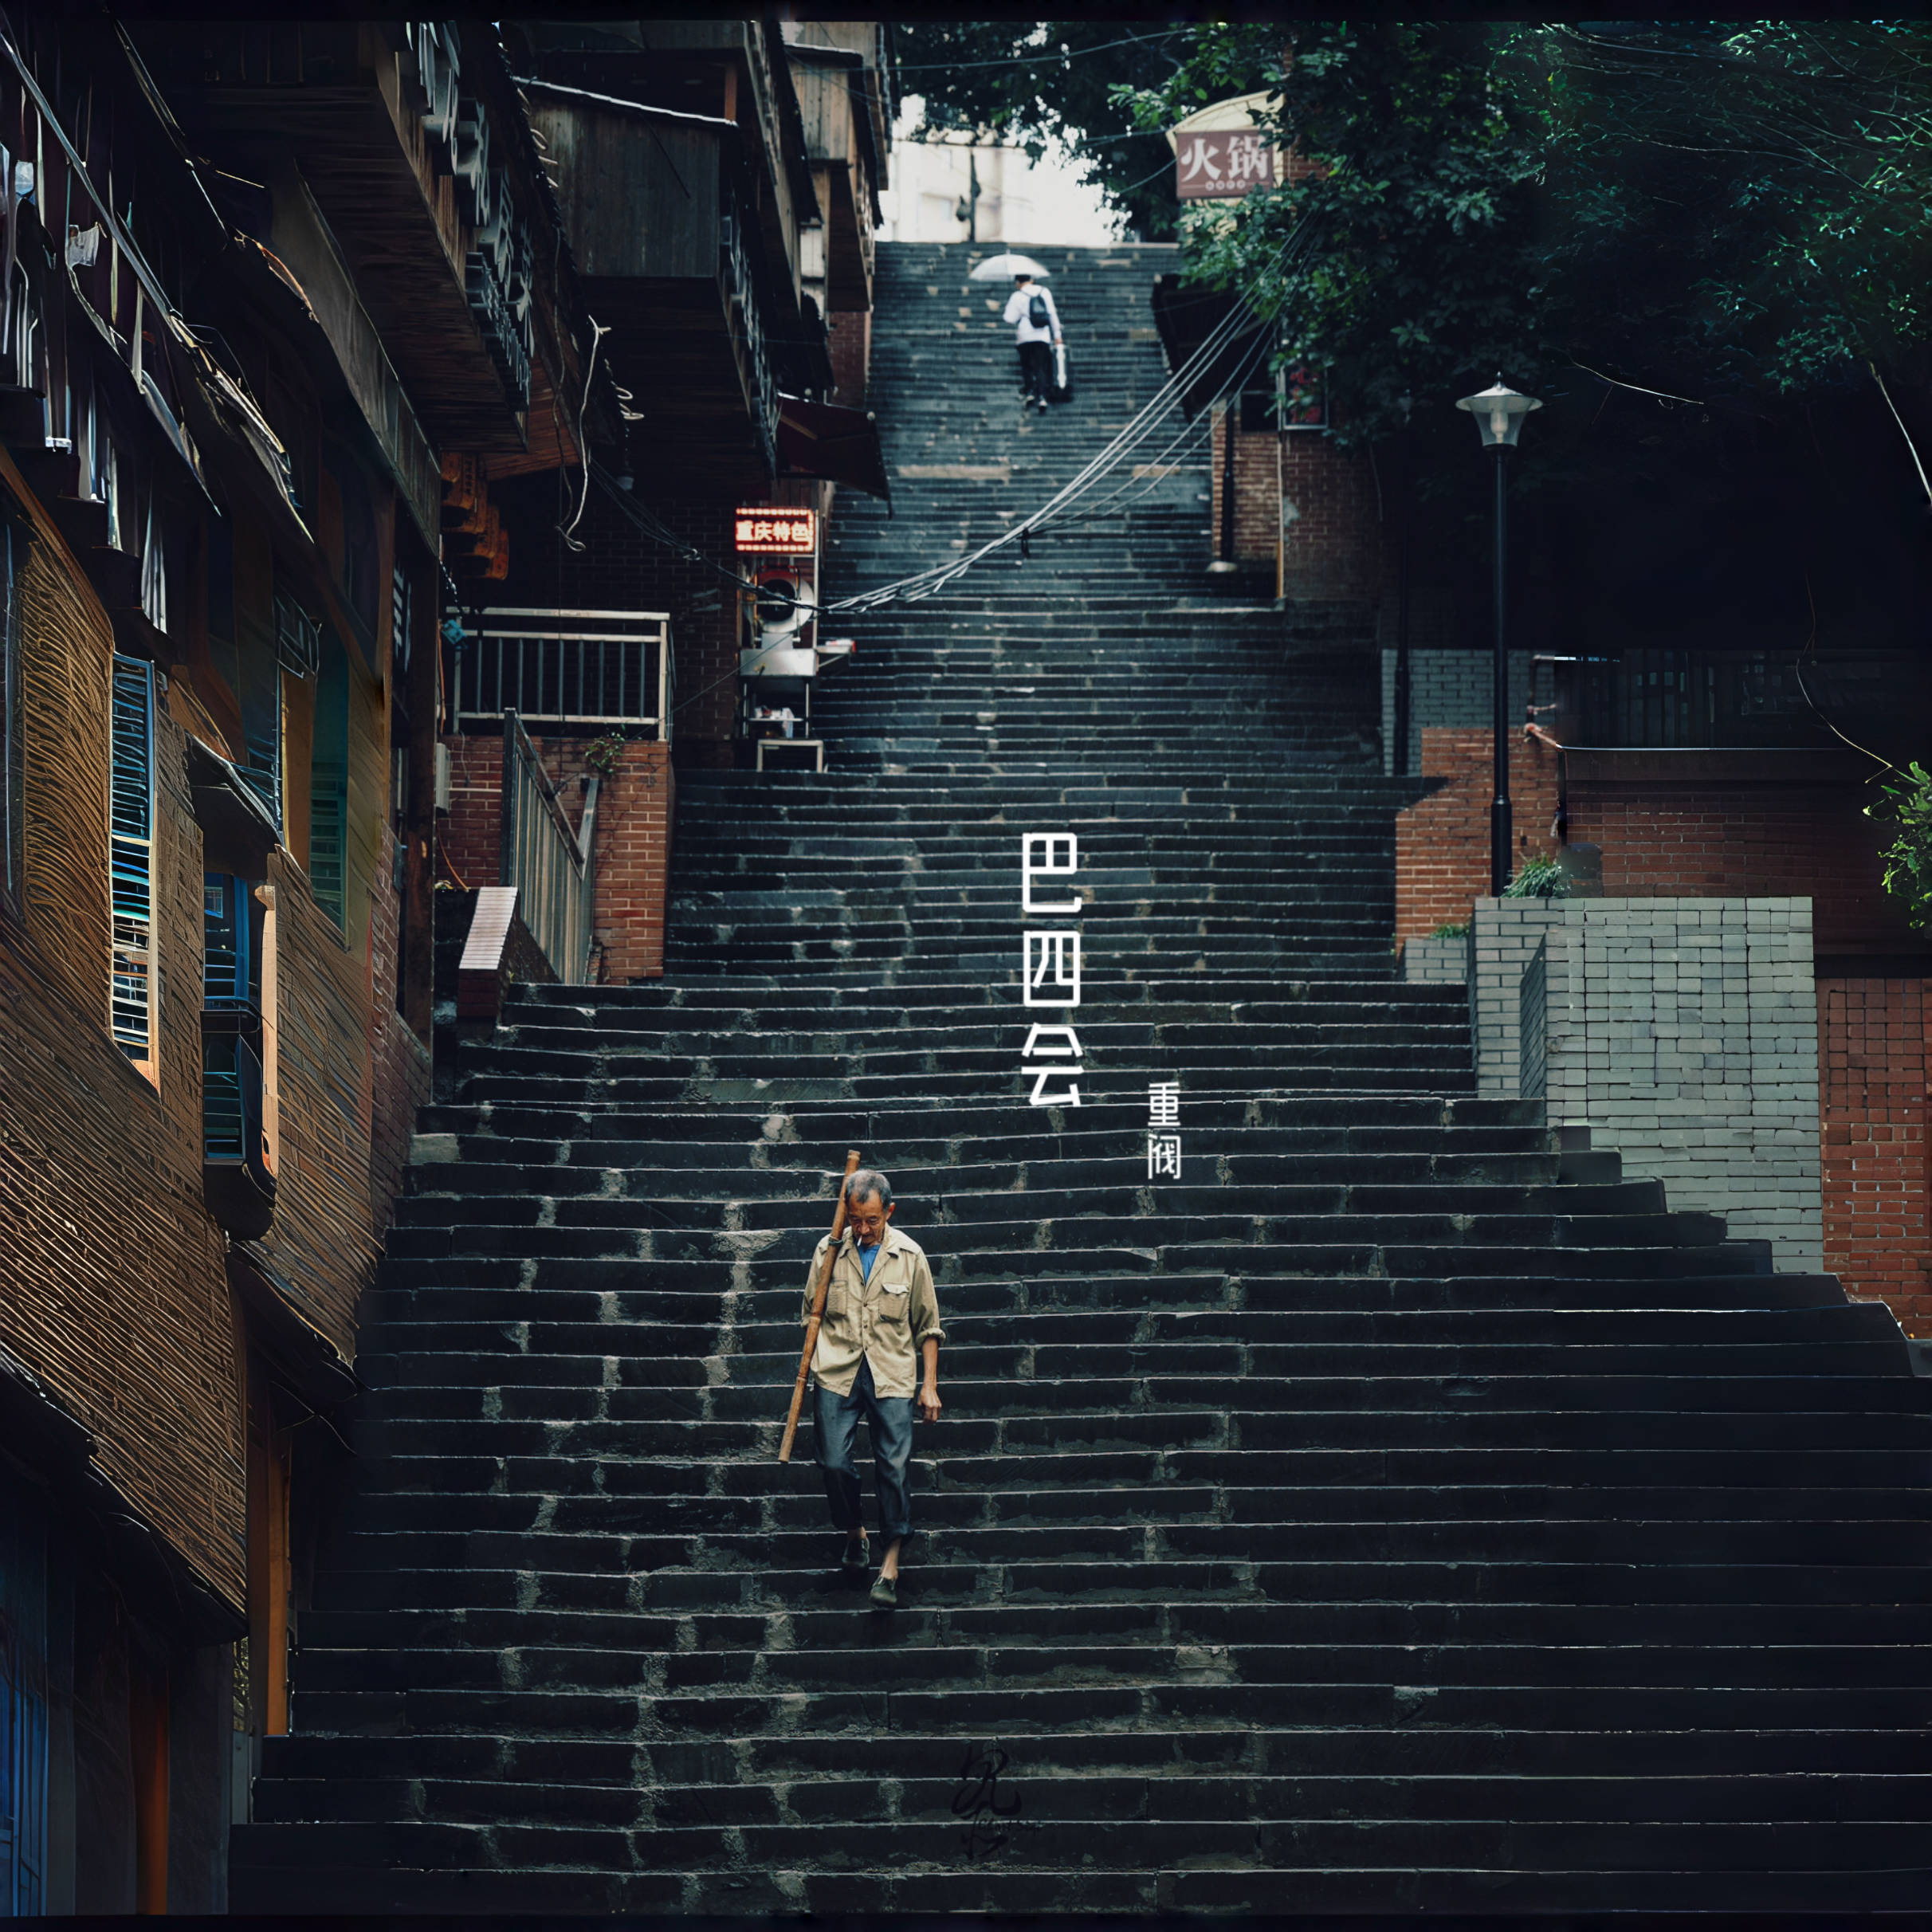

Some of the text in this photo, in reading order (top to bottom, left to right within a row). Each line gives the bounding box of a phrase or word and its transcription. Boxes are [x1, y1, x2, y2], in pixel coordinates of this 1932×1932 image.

[1180, 135, 1269, 183] 火锅
[736, 520, 810, 542] 重庆特色
